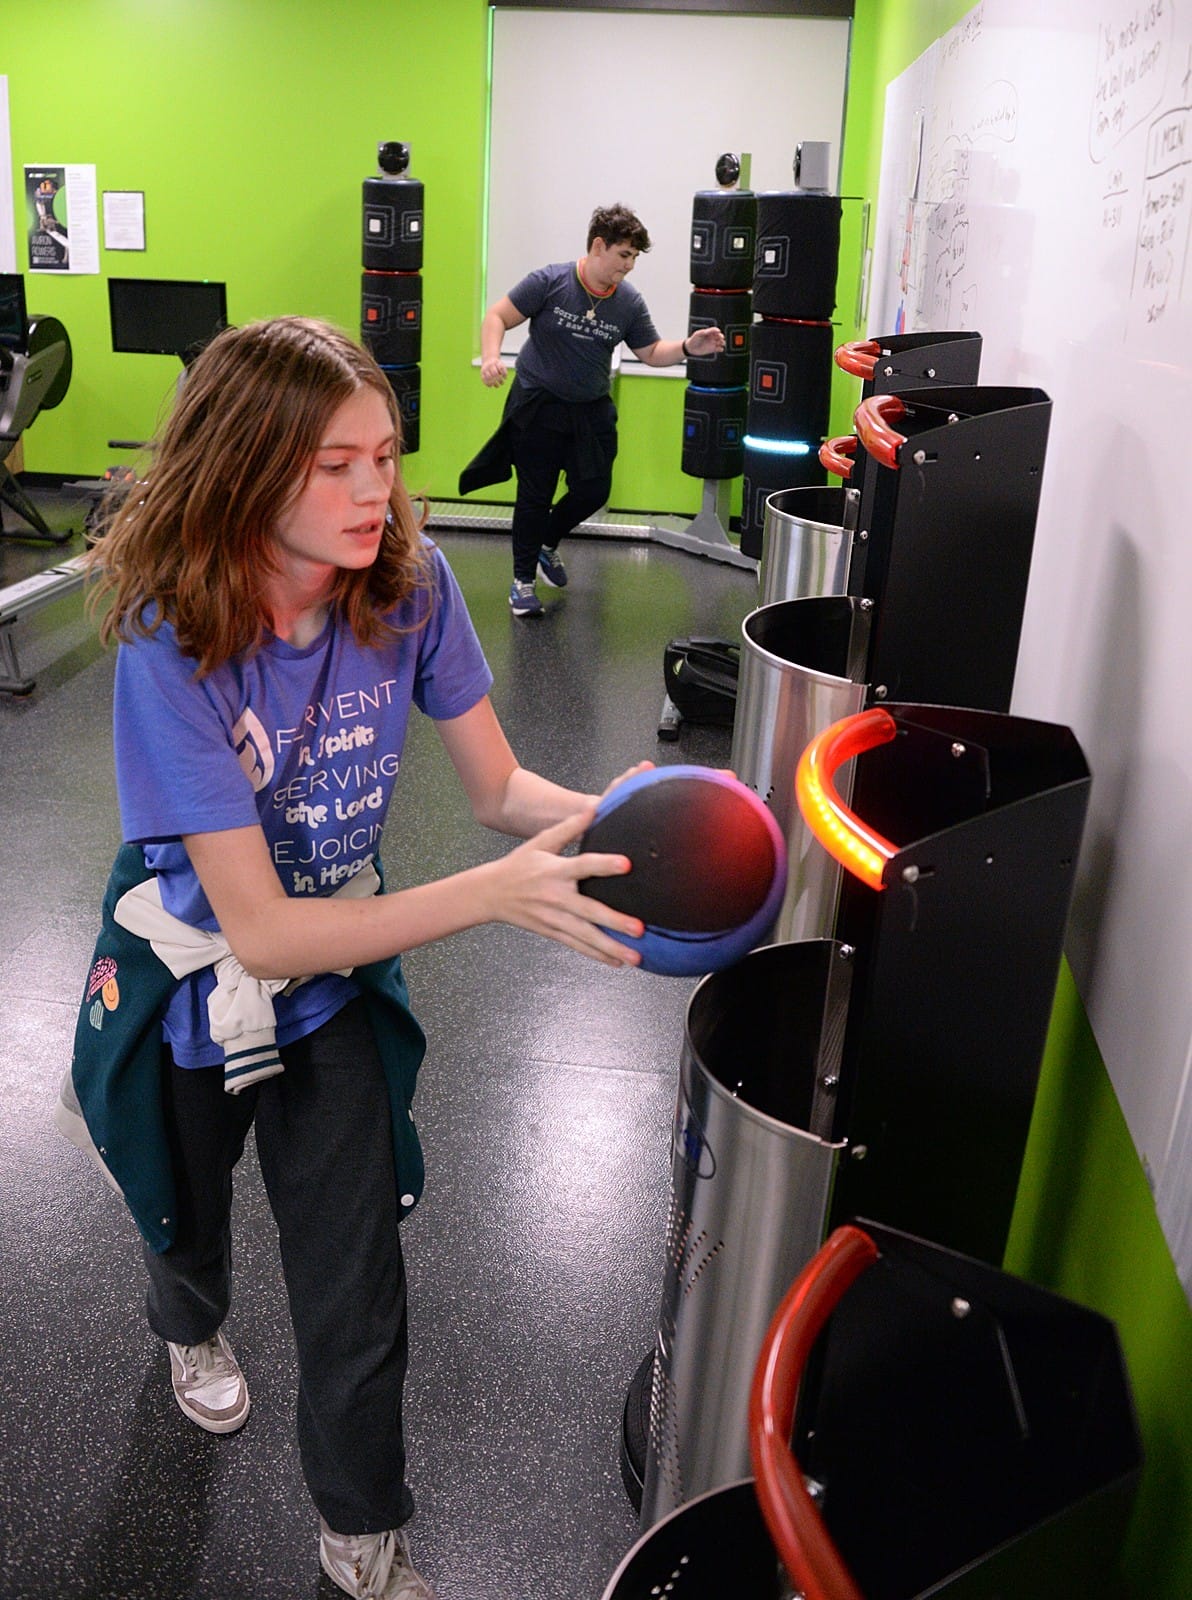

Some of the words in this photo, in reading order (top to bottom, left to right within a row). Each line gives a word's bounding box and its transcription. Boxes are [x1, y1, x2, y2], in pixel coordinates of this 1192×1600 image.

[1161, 119, 1186, 158] MIN
[553, 306, 579, 322] Sorry
[581, 315, 597, 326] Im
[600, 320, 620, 333] late.
[557, 317, 564, 325] I
[566, 322, 583, 330] saw
[592, 328, 612, 340] dog.
[298, 745, 316, 767] n
[273, 754, 400, 809] SERVING
[286, 801, 329, 829] the
[335, 785, 383, 821] Lord
[274, 823, 383, 864] EJOICIN
[293, 871, 317, 893] in
